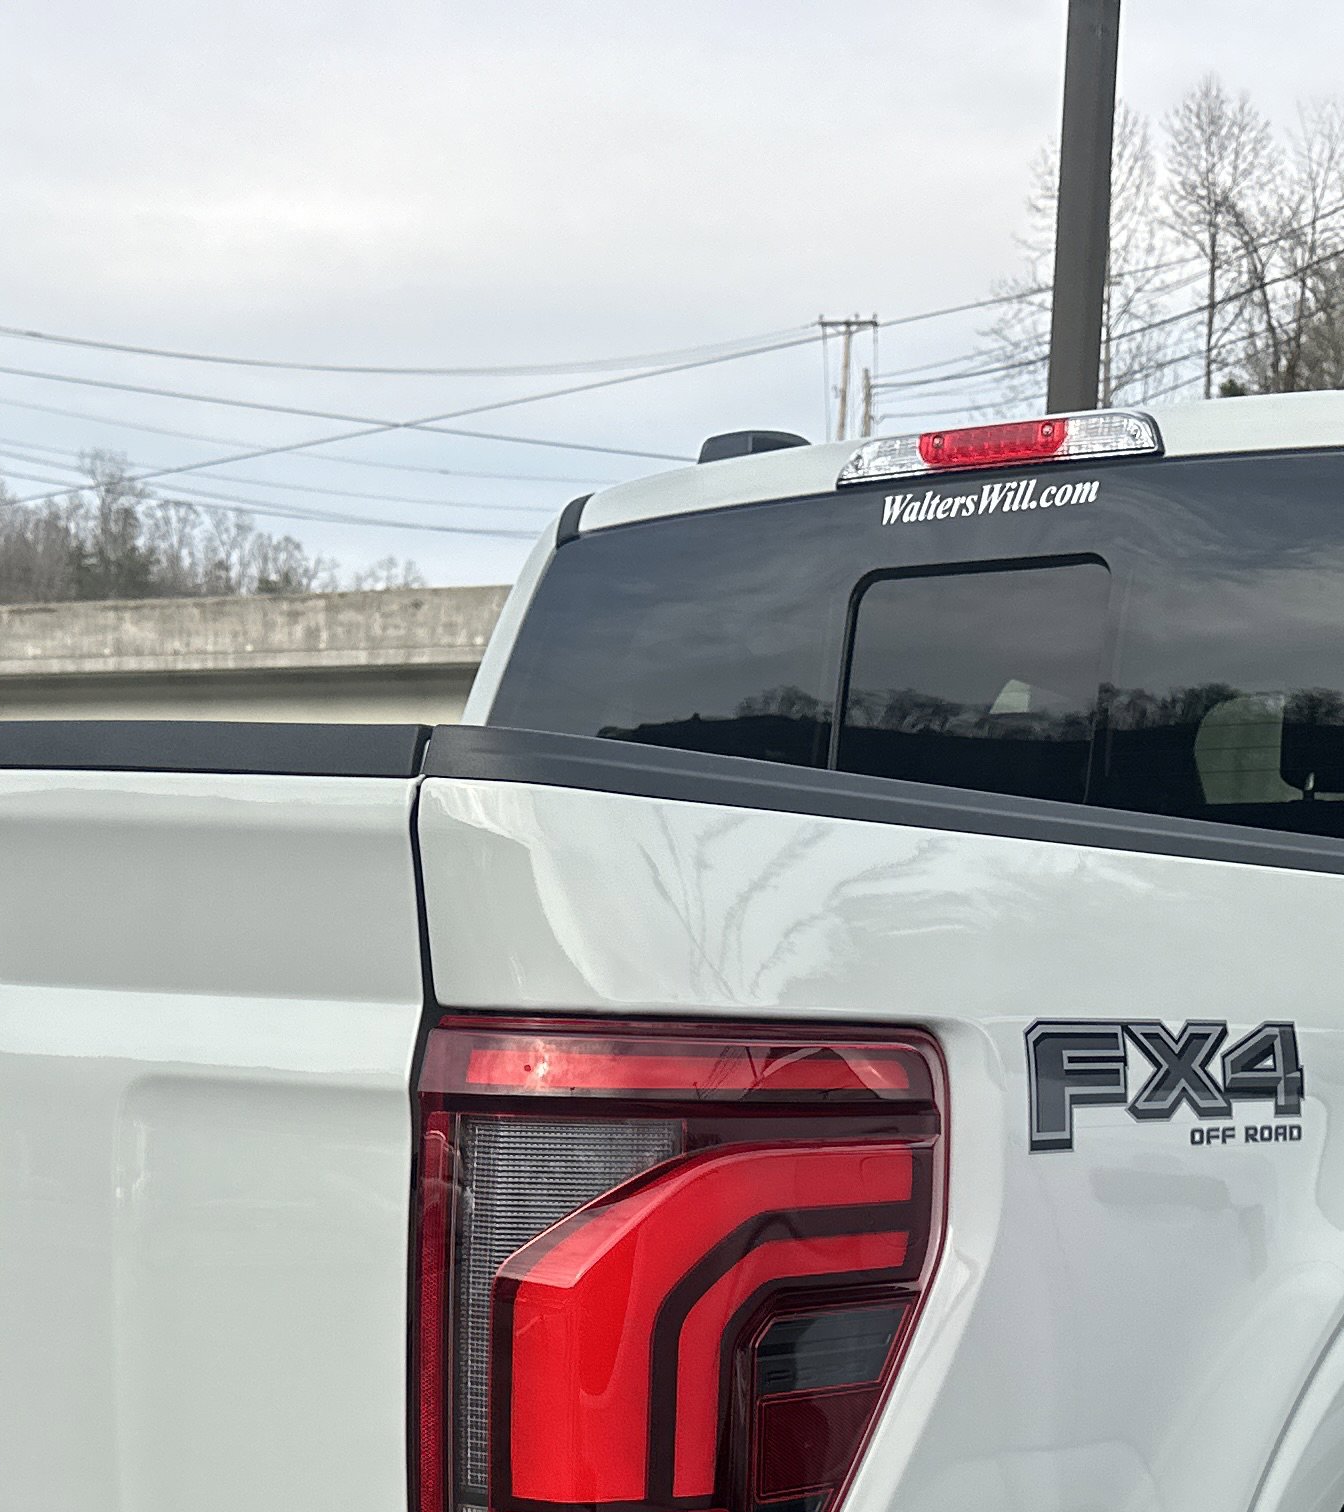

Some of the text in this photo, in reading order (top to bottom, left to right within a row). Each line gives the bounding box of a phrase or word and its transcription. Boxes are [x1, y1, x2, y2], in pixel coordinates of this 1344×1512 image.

[881, 479, 1100, 525] WaltersWill.com
[1023, 1017, 1304, 1155] FX4
[1190, 1125, 1302, 1145] OFF ROAD
